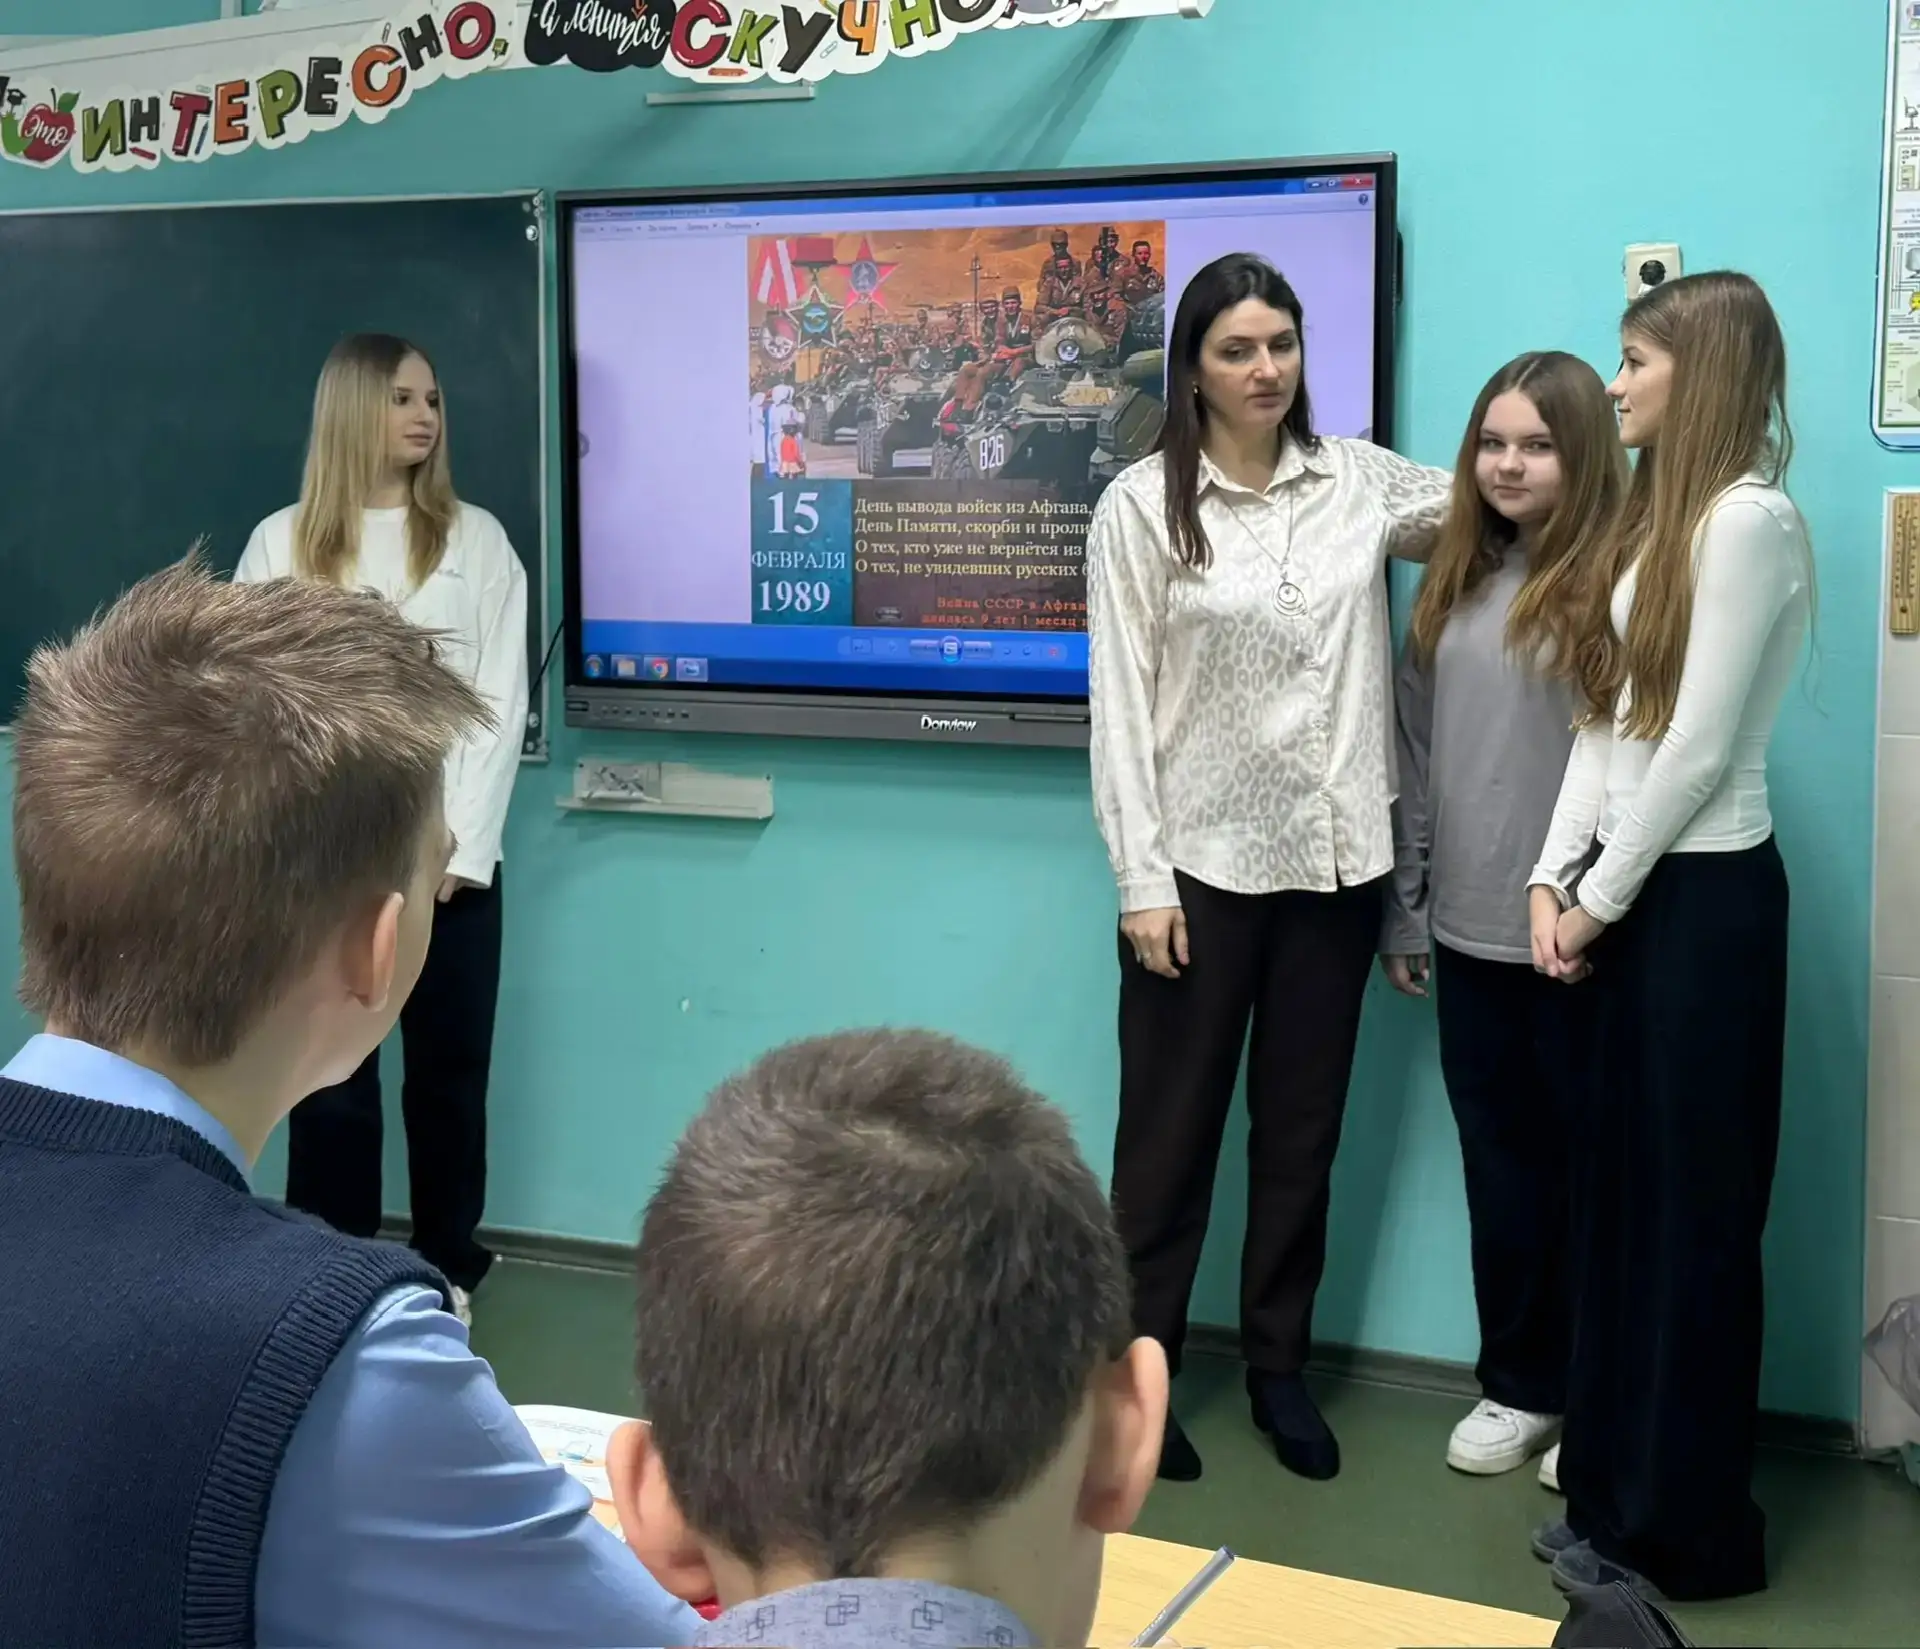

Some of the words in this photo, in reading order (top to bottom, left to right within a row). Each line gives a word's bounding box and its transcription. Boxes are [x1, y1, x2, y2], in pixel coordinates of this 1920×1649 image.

[24, 113, 70, 146] Это
[82, 1, 508, 163] ИНТЕРЕСНО,
[540, 0, 560, 37] а
[980, 433, 1004, 471] 826
[768, 491, 819, 534] 15
[855, 498, 893, 514] День
[896, 502, 952, 515] вывода
[957, 498, 1002, 513] войск
[1006, 503, 1025, 513] из
[1028, 499, 1093, 518] Афгана,
[855, 518, 893, 534] День
[897, 518, 962, 537] Памяти,
[965, 519, 1021, 539] скорби
[1026, 523, 1036, 534] и
[855, 539, 868, 553] О
[871, 543, 900, 556] тех,
[904, 543, 930, 554] кто
[933, 543, 963, 558] уже
[967, 544, 985, 555] не
[990, 541, 1059, 559] вернётся
[1063, 545, 1082, 556] из
[752, 551, 846, 569] ФЕВРАЛЯ
[855, 559, 868, 572] О
[871, 562, 900, 576] тех,
[904, 563, 922, 573] не
[924, 563, 1012, 578] увидевших
[1016, 565, 1078, 579] русских
[759, 580, 831, 613] 1989
[984, 598, 1024, 609] СССР
[921, 714, 977, 732] Donview
